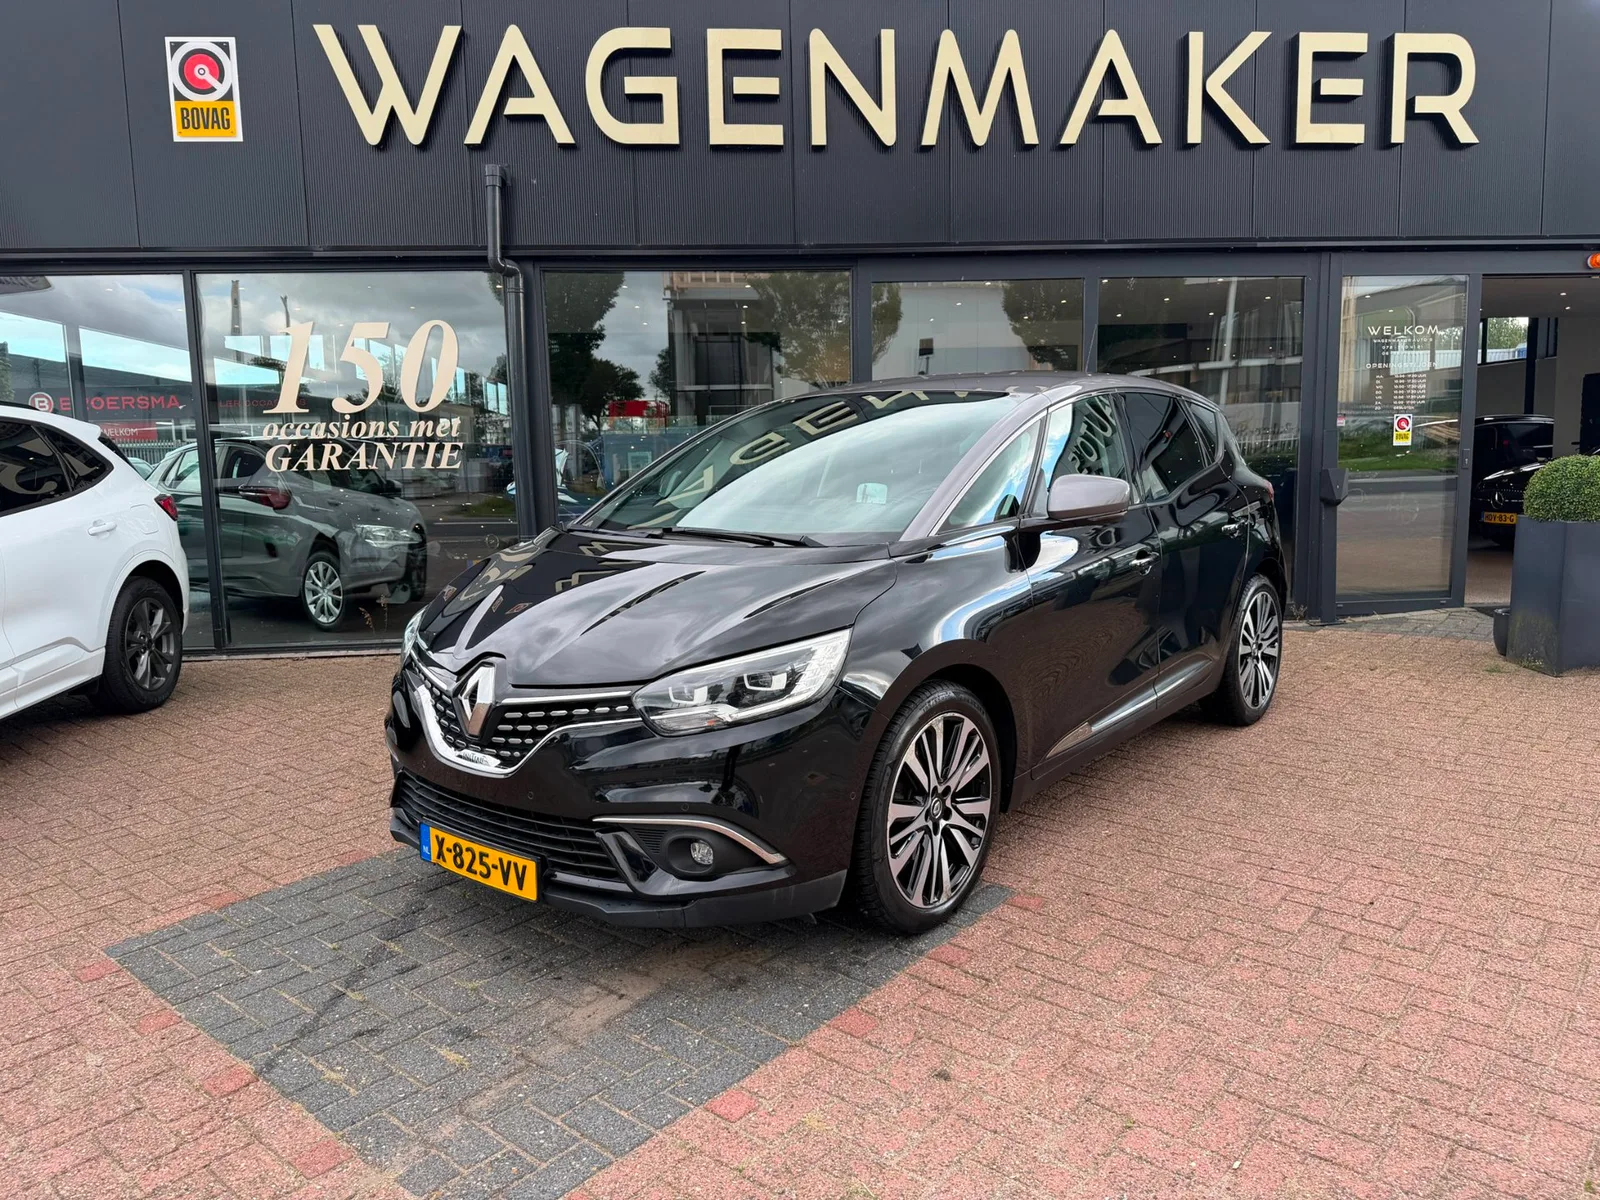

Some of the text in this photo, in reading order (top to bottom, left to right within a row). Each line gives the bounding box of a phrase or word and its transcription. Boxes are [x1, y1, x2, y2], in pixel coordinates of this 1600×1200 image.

[313, 24, 1480, 147] WAGENMAKER
[180, 107, 231, 130] BOVAG
[1368, 325, 1439, 336] WELKOM
[263, 319, 459, 414] 150
[263, 414, 461, 439] occasions met
[265, 441, 464, 473] GARANTIE
[435, 834, 527, 891] X-825-VV
